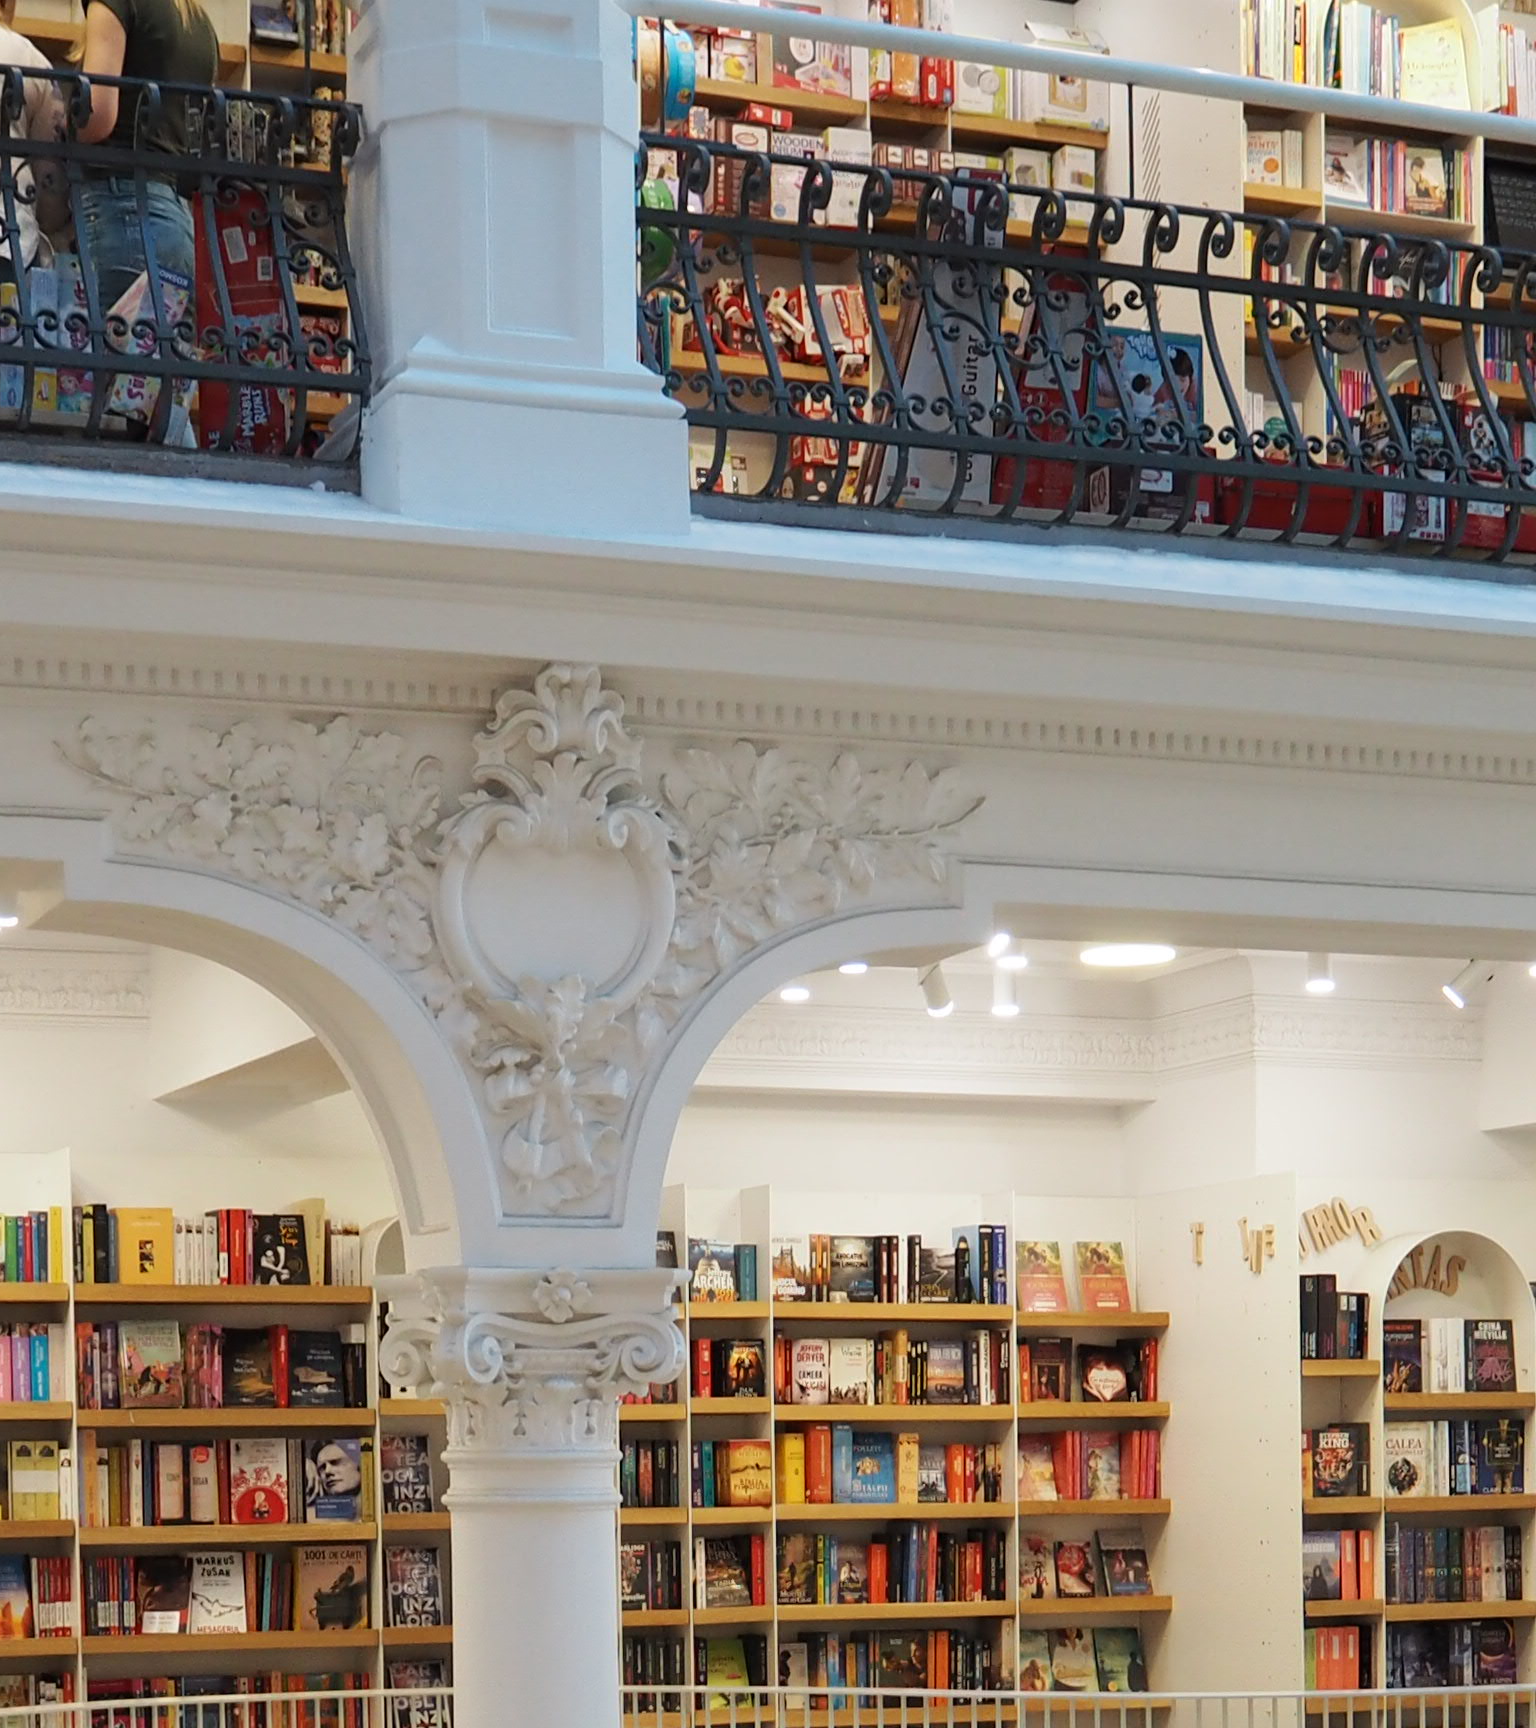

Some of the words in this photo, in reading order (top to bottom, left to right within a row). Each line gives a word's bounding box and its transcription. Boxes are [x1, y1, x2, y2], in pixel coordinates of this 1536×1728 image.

[772, 135, 824, 150] WOODEN
[961, 335, 980, 397] Guitar
[1319, 1439, 1349, 1449] KING
[196, 1556, 235, 1566] MARKUS
